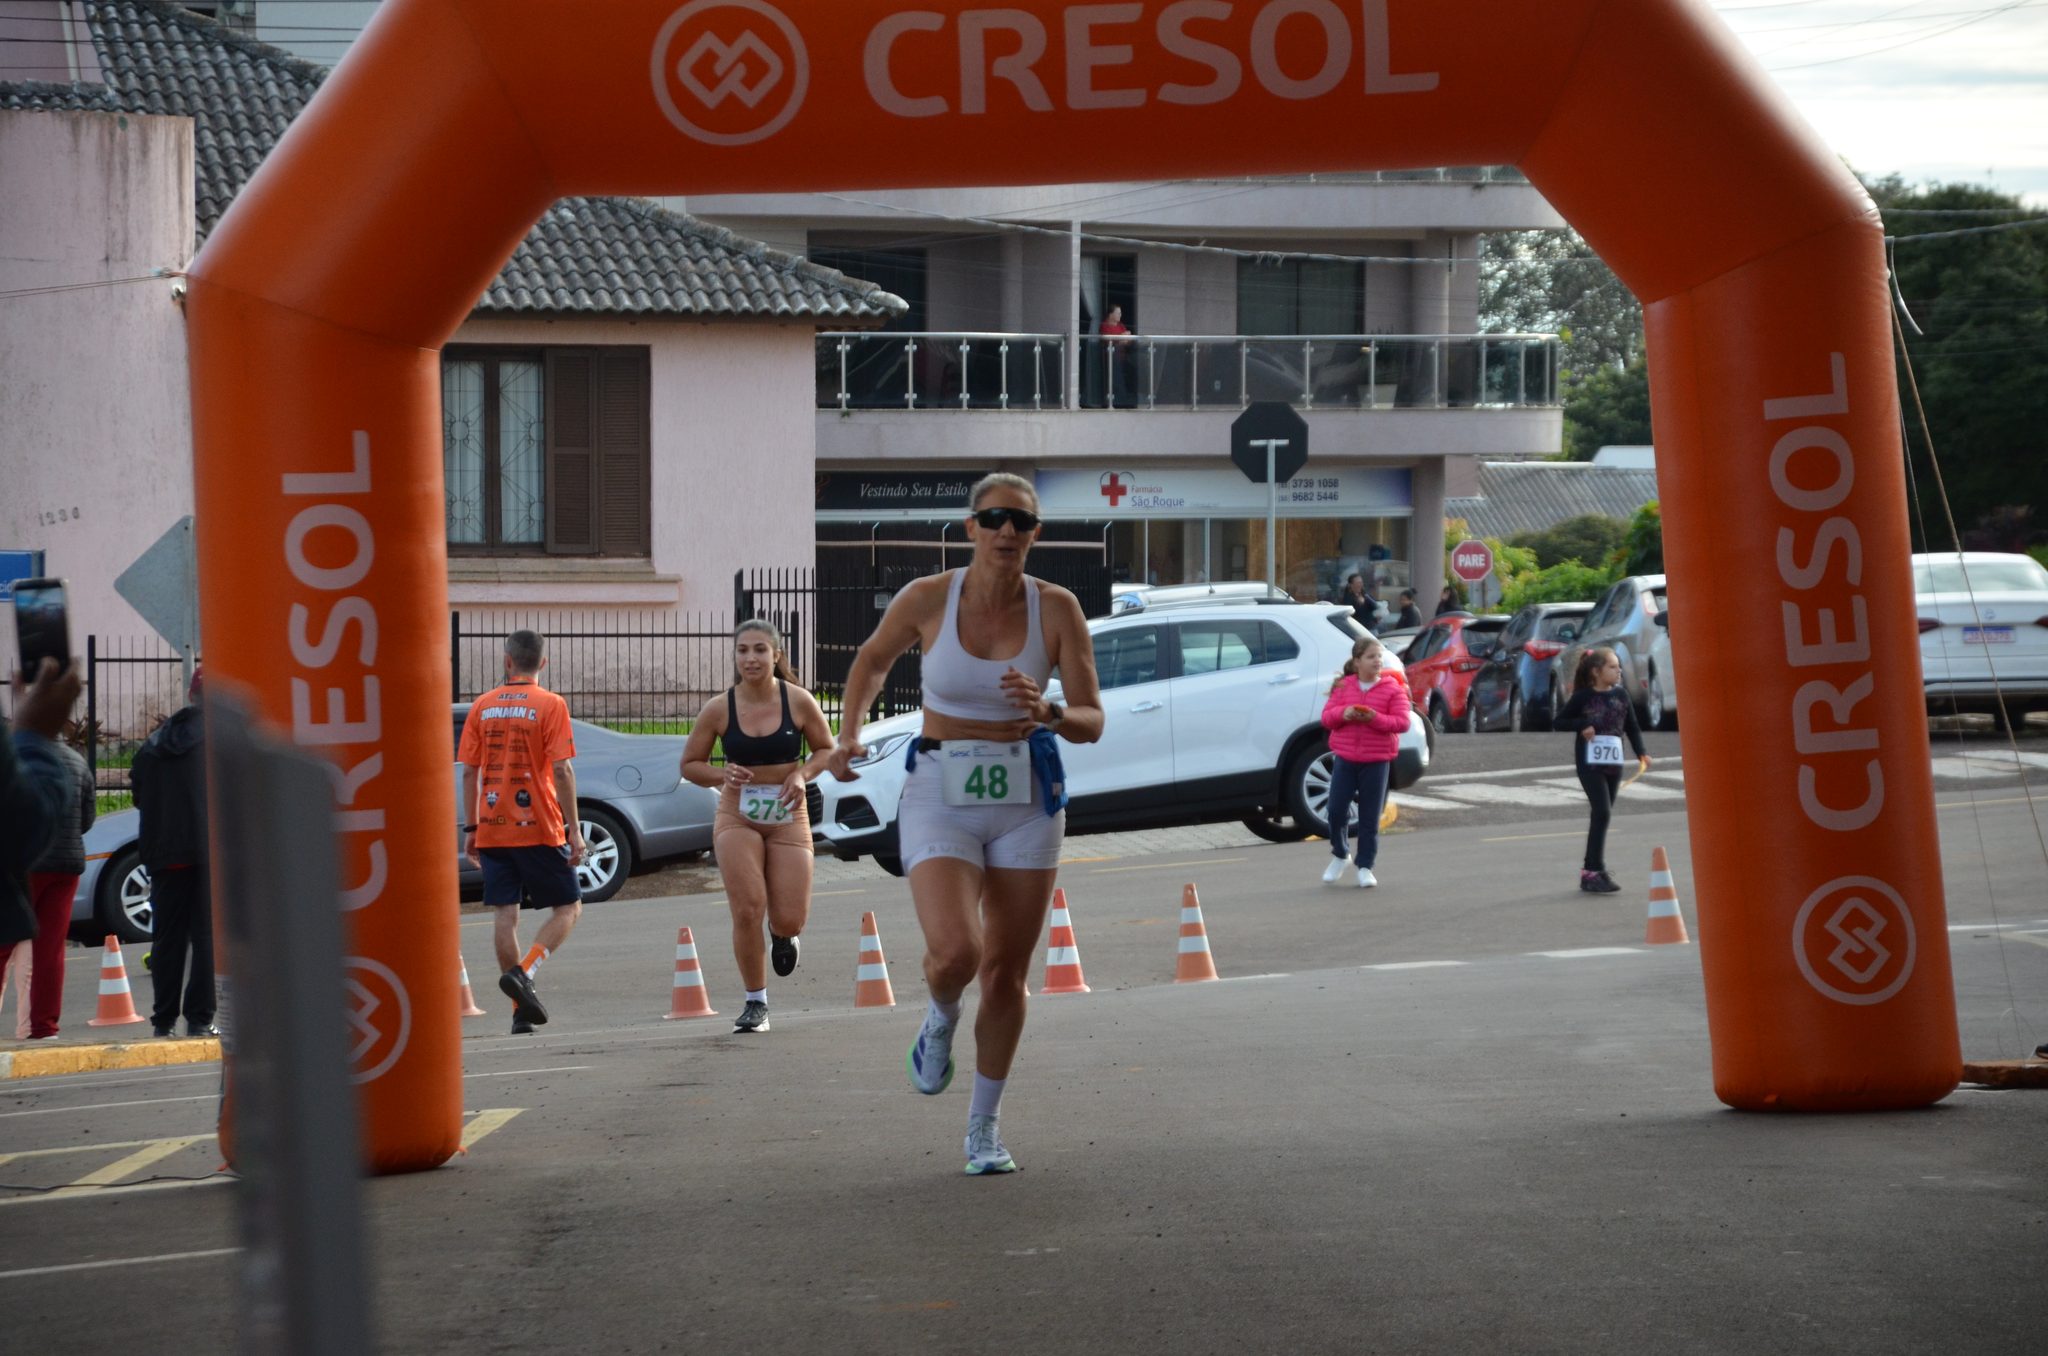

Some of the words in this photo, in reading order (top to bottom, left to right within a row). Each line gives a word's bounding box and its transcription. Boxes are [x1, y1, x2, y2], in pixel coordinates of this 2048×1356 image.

[862, 0, 1440, 118] CRESOL
[860, 483, 908, 498] Vestindo
[911, 483, 932, 497] Seu
[936, 482, 968, 497] Estilo
[1153, 496, 1185, 508] Roque
[1458, 554, 1486, 567] PARE
[1763, 351, 1885, 831] CRESOL
[1593, 746, 1620, 761] 970
[965, 764, 1009, 800] 48
